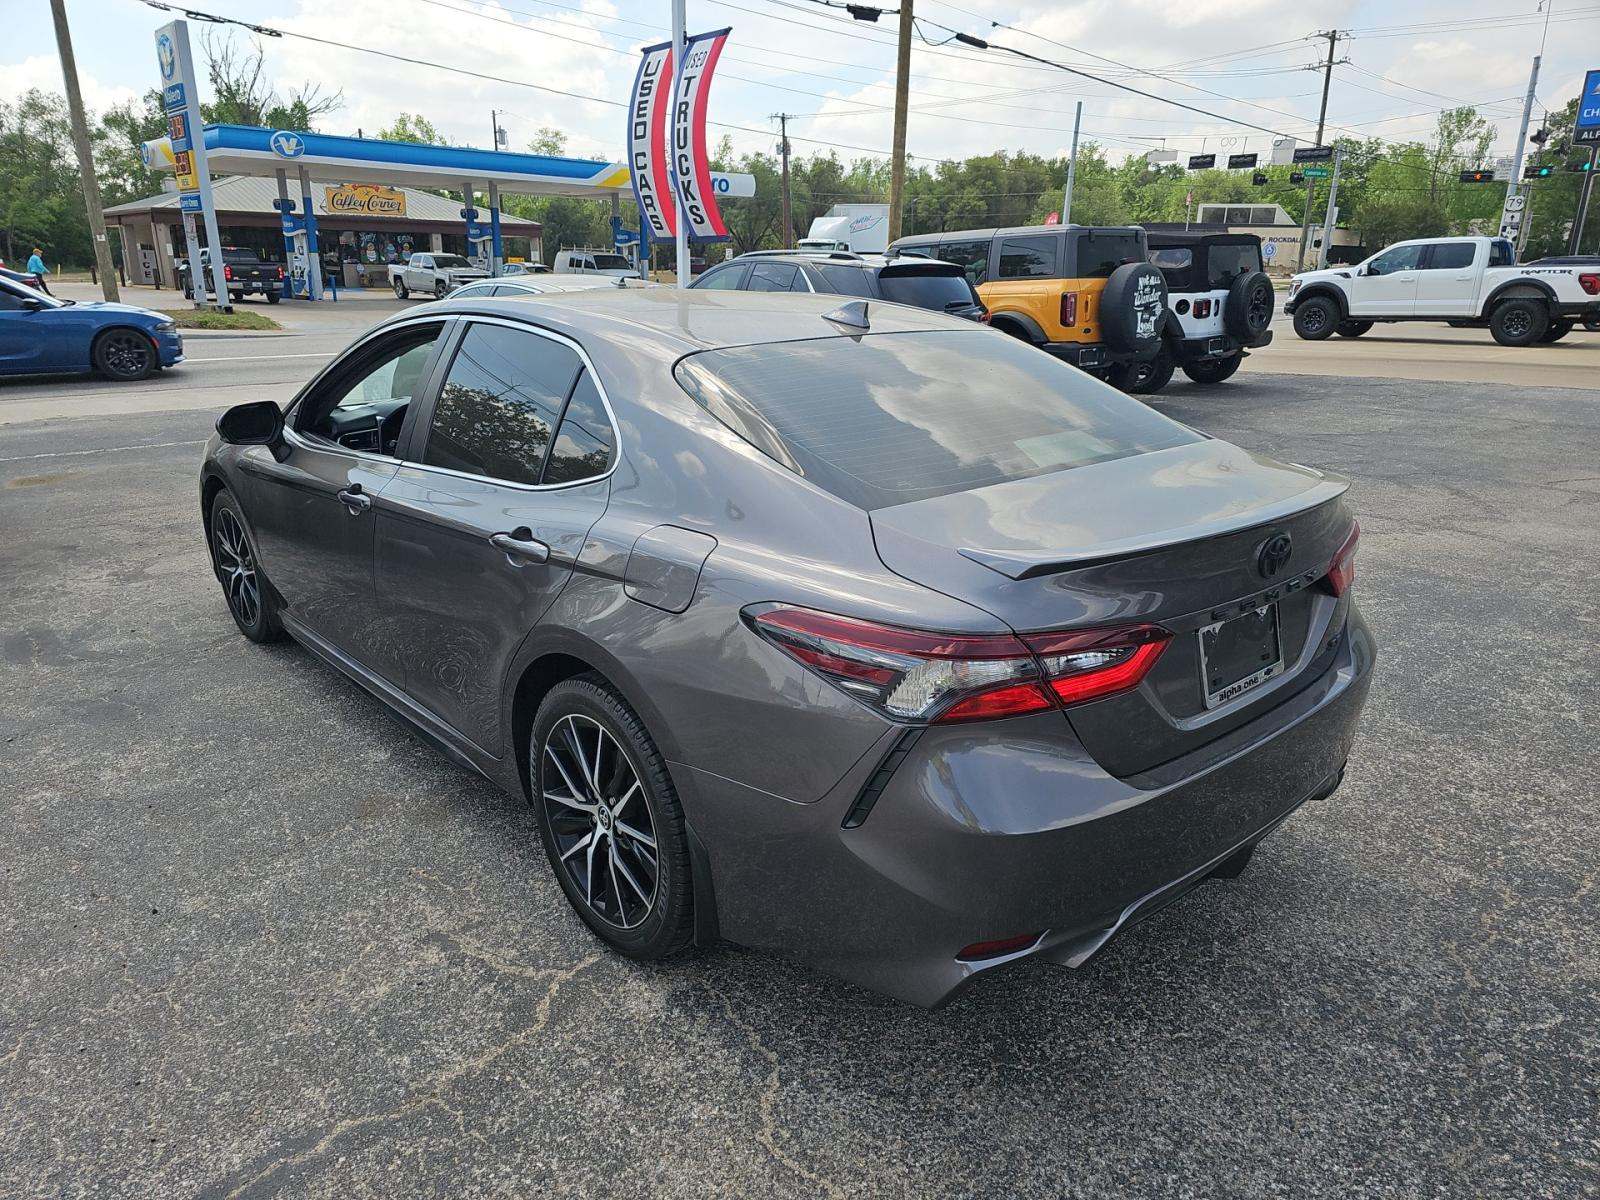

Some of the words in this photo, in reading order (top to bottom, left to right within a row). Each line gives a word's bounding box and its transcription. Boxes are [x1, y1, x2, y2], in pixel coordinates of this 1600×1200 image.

[685, 51, 708, 70] USED
[633, 60, 662, 141] USED
[676, 75, 706, 225] TRUCKS
[331, 192, 366, 212] Caffey
[367, 194, 402, 213] Corner
[634, 152, 664, 231] CARS
[1508, 198, 1523, 208] 79
[142, 251, 152, 279] ICE
[1218, 684, 1242, 702] alpha
[1243, 676, 1260, 689] one
